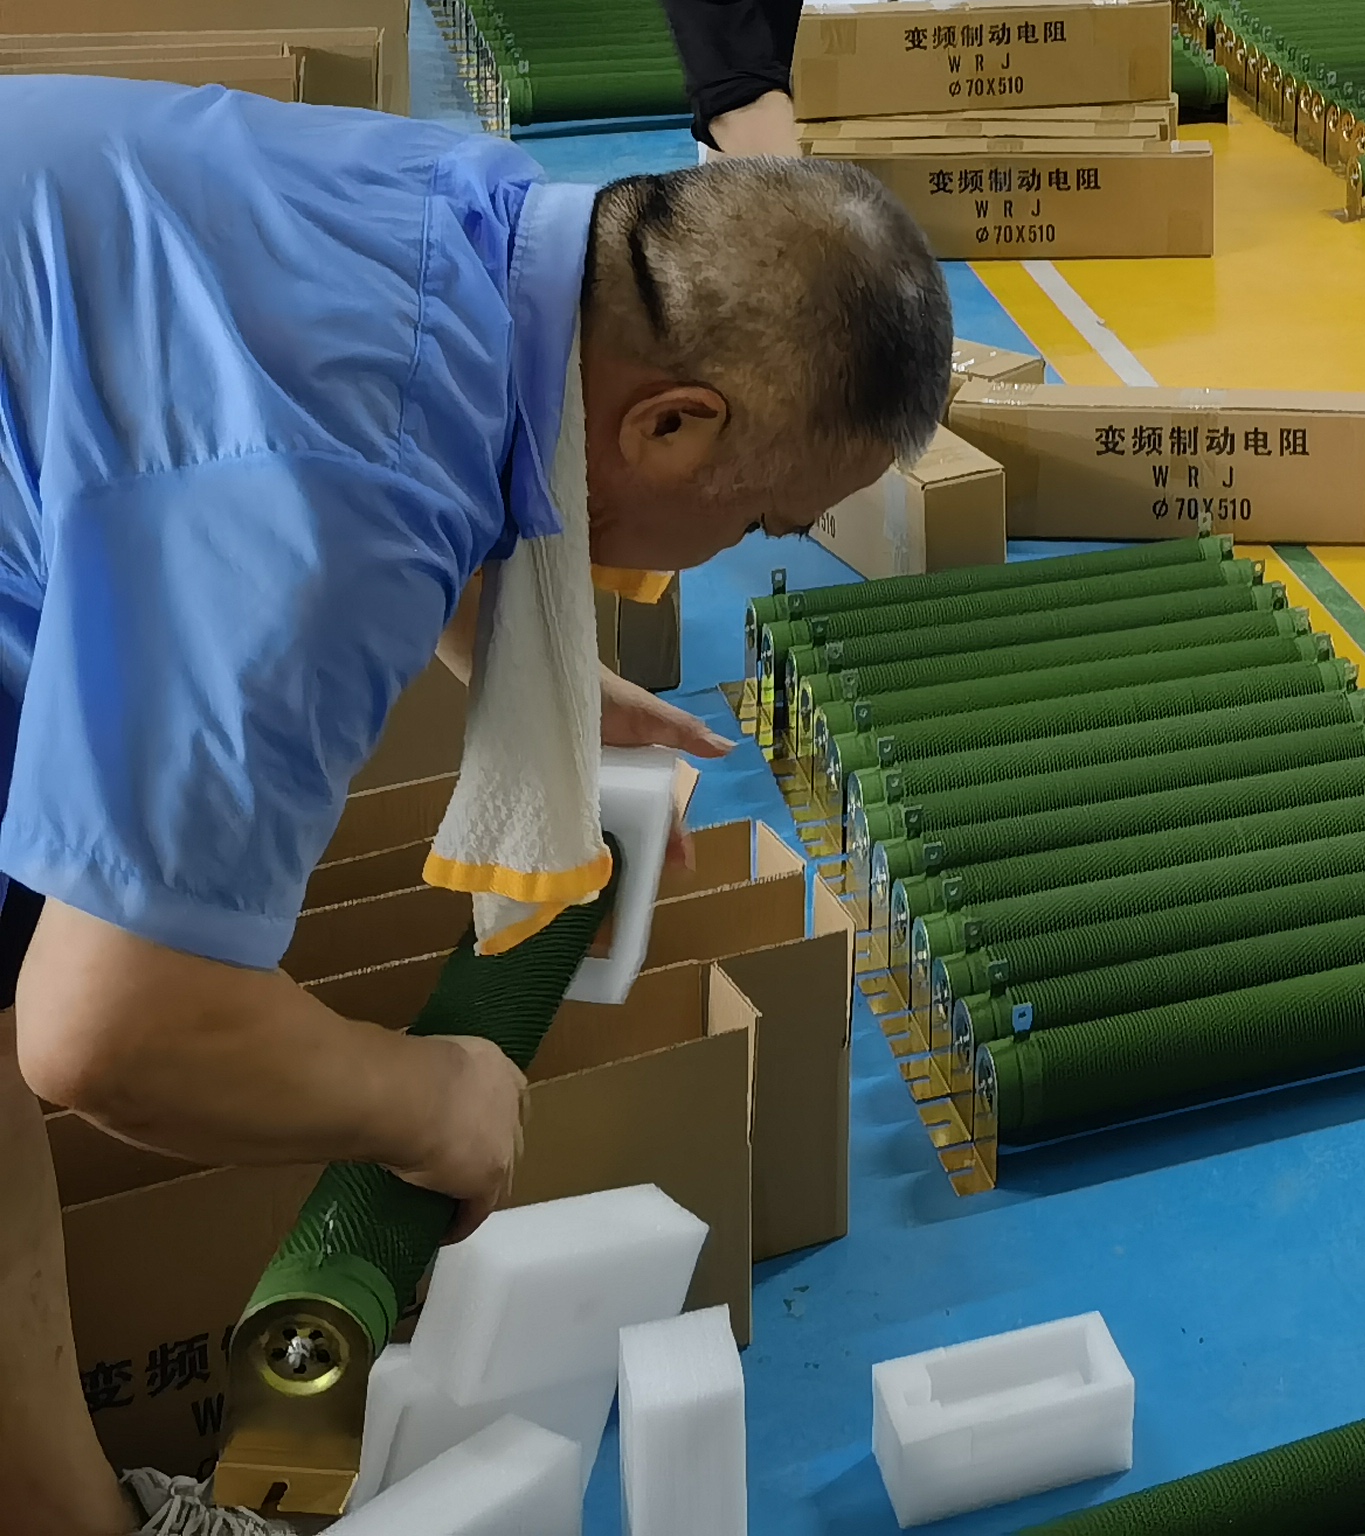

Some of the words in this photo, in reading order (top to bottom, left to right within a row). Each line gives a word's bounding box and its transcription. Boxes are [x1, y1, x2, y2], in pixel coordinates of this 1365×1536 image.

[904, 21, 1067, 52] 变频制动电阻
[929, 167, 1101, 195] 变频制动电阻
[1095, 425, 1310, 456] 变频制动电阻
[81, 1325, 235, 1413] 变频
